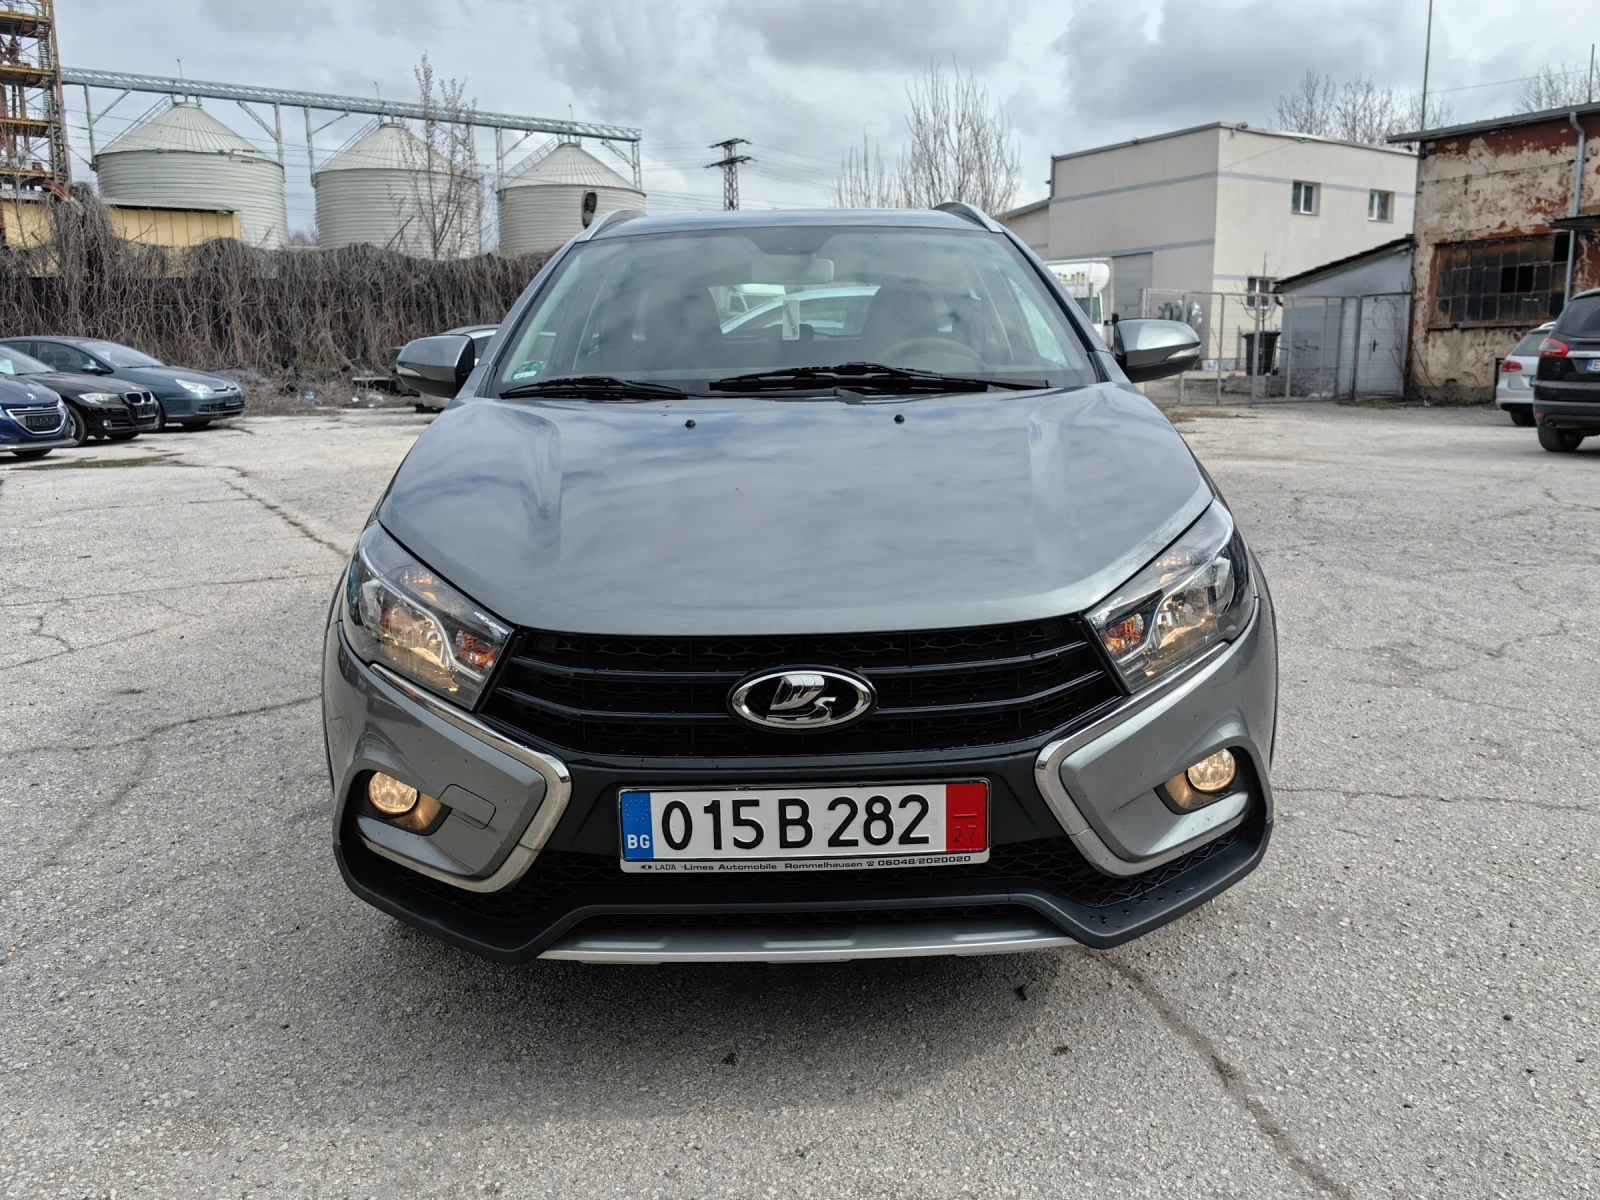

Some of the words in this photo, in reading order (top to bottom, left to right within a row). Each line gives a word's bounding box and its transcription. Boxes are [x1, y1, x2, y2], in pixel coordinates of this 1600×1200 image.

[627, 834, 651, 849] BG
[953, 825, 977, 843] 27
[655, 863, 677, 871] LADA
[718, 862, 777, 871] Automobile
[878, 855, 971, 866] 06048/2020020
